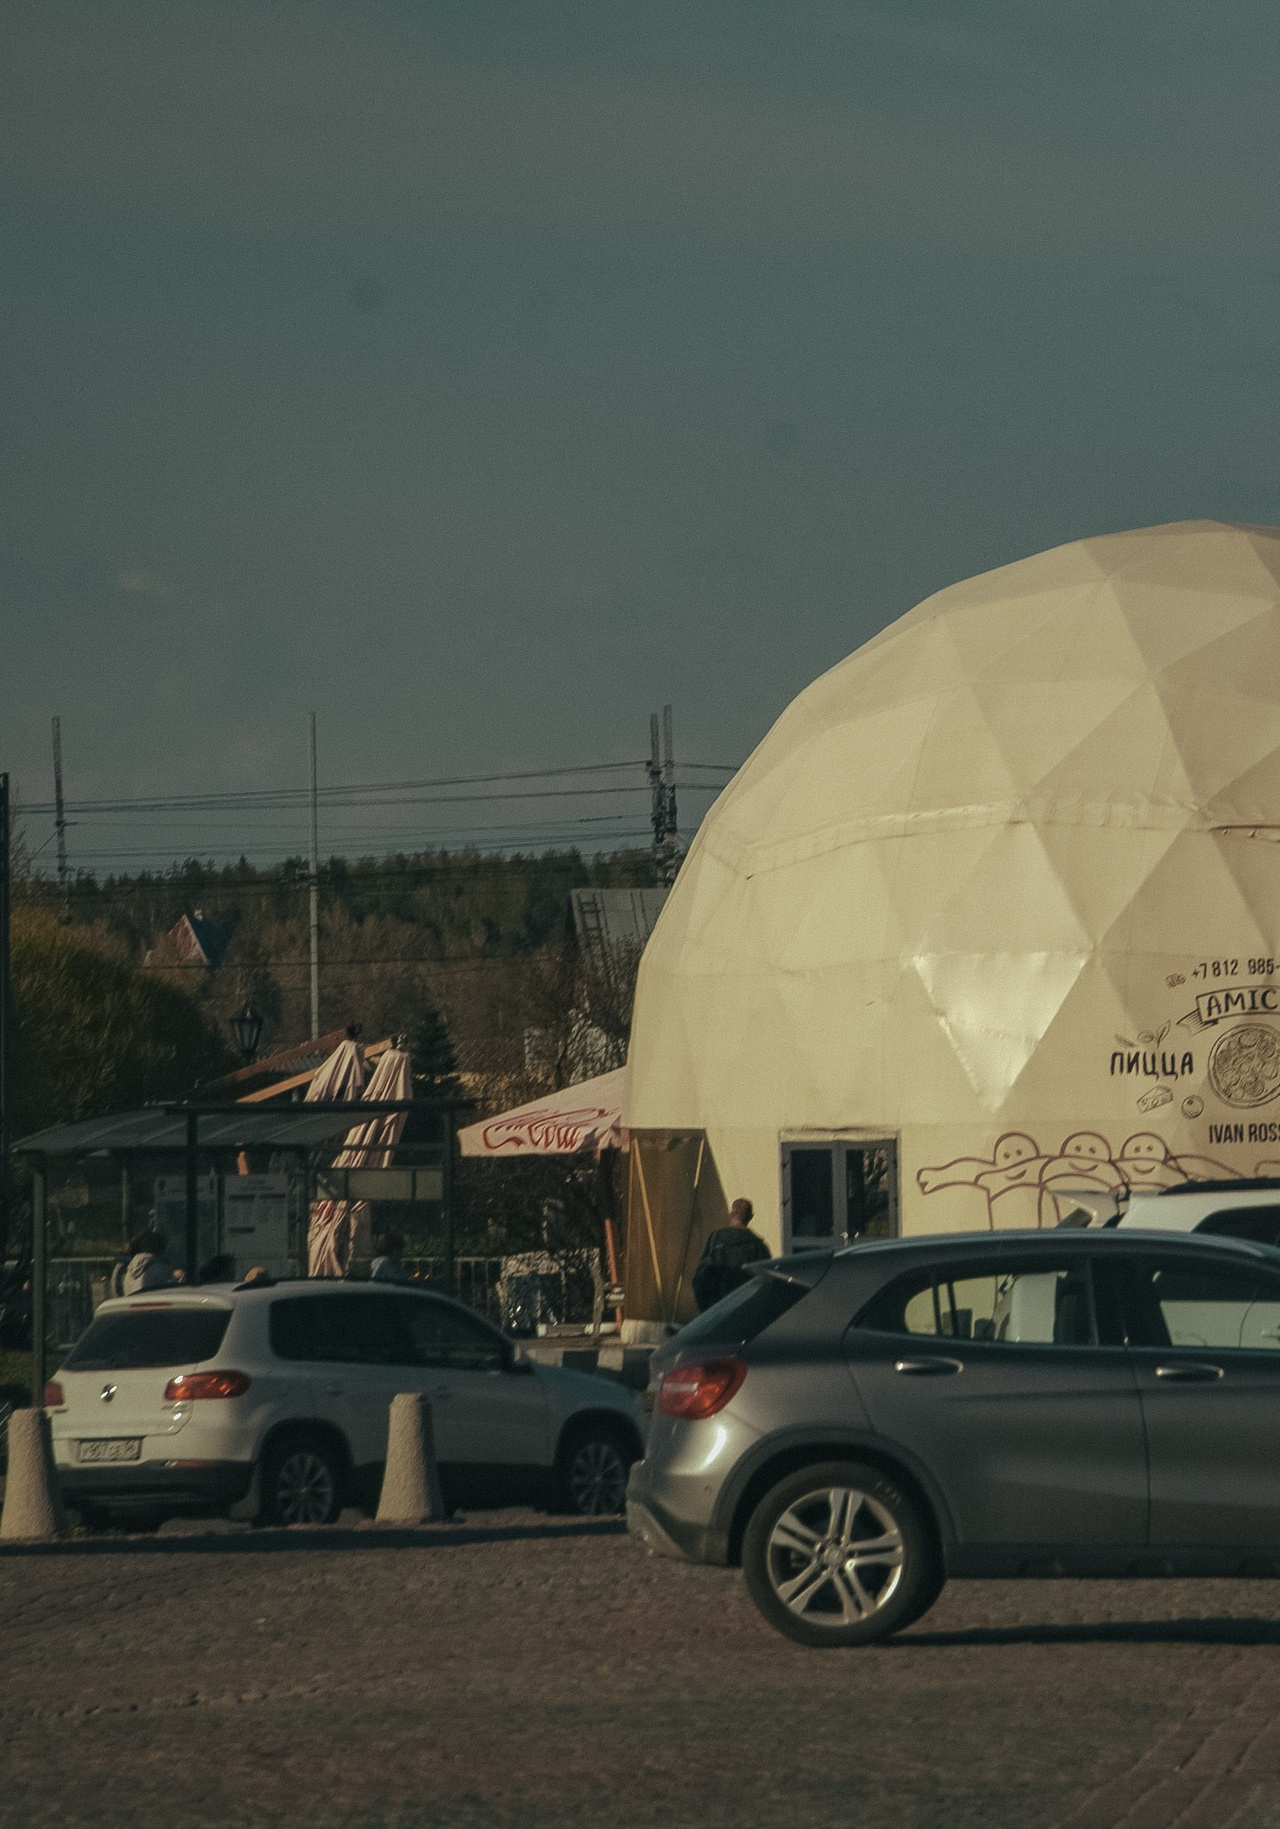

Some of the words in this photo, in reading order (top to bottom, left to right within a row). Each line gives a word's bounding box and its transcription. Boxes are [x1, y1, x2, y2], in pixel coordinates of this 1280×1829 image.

[1211, 959, 1239, 977] 812
[1110, 1051, 1194, 1081] ПИЦЦА
[1208, 1123, 1244, 1144] IVAN
